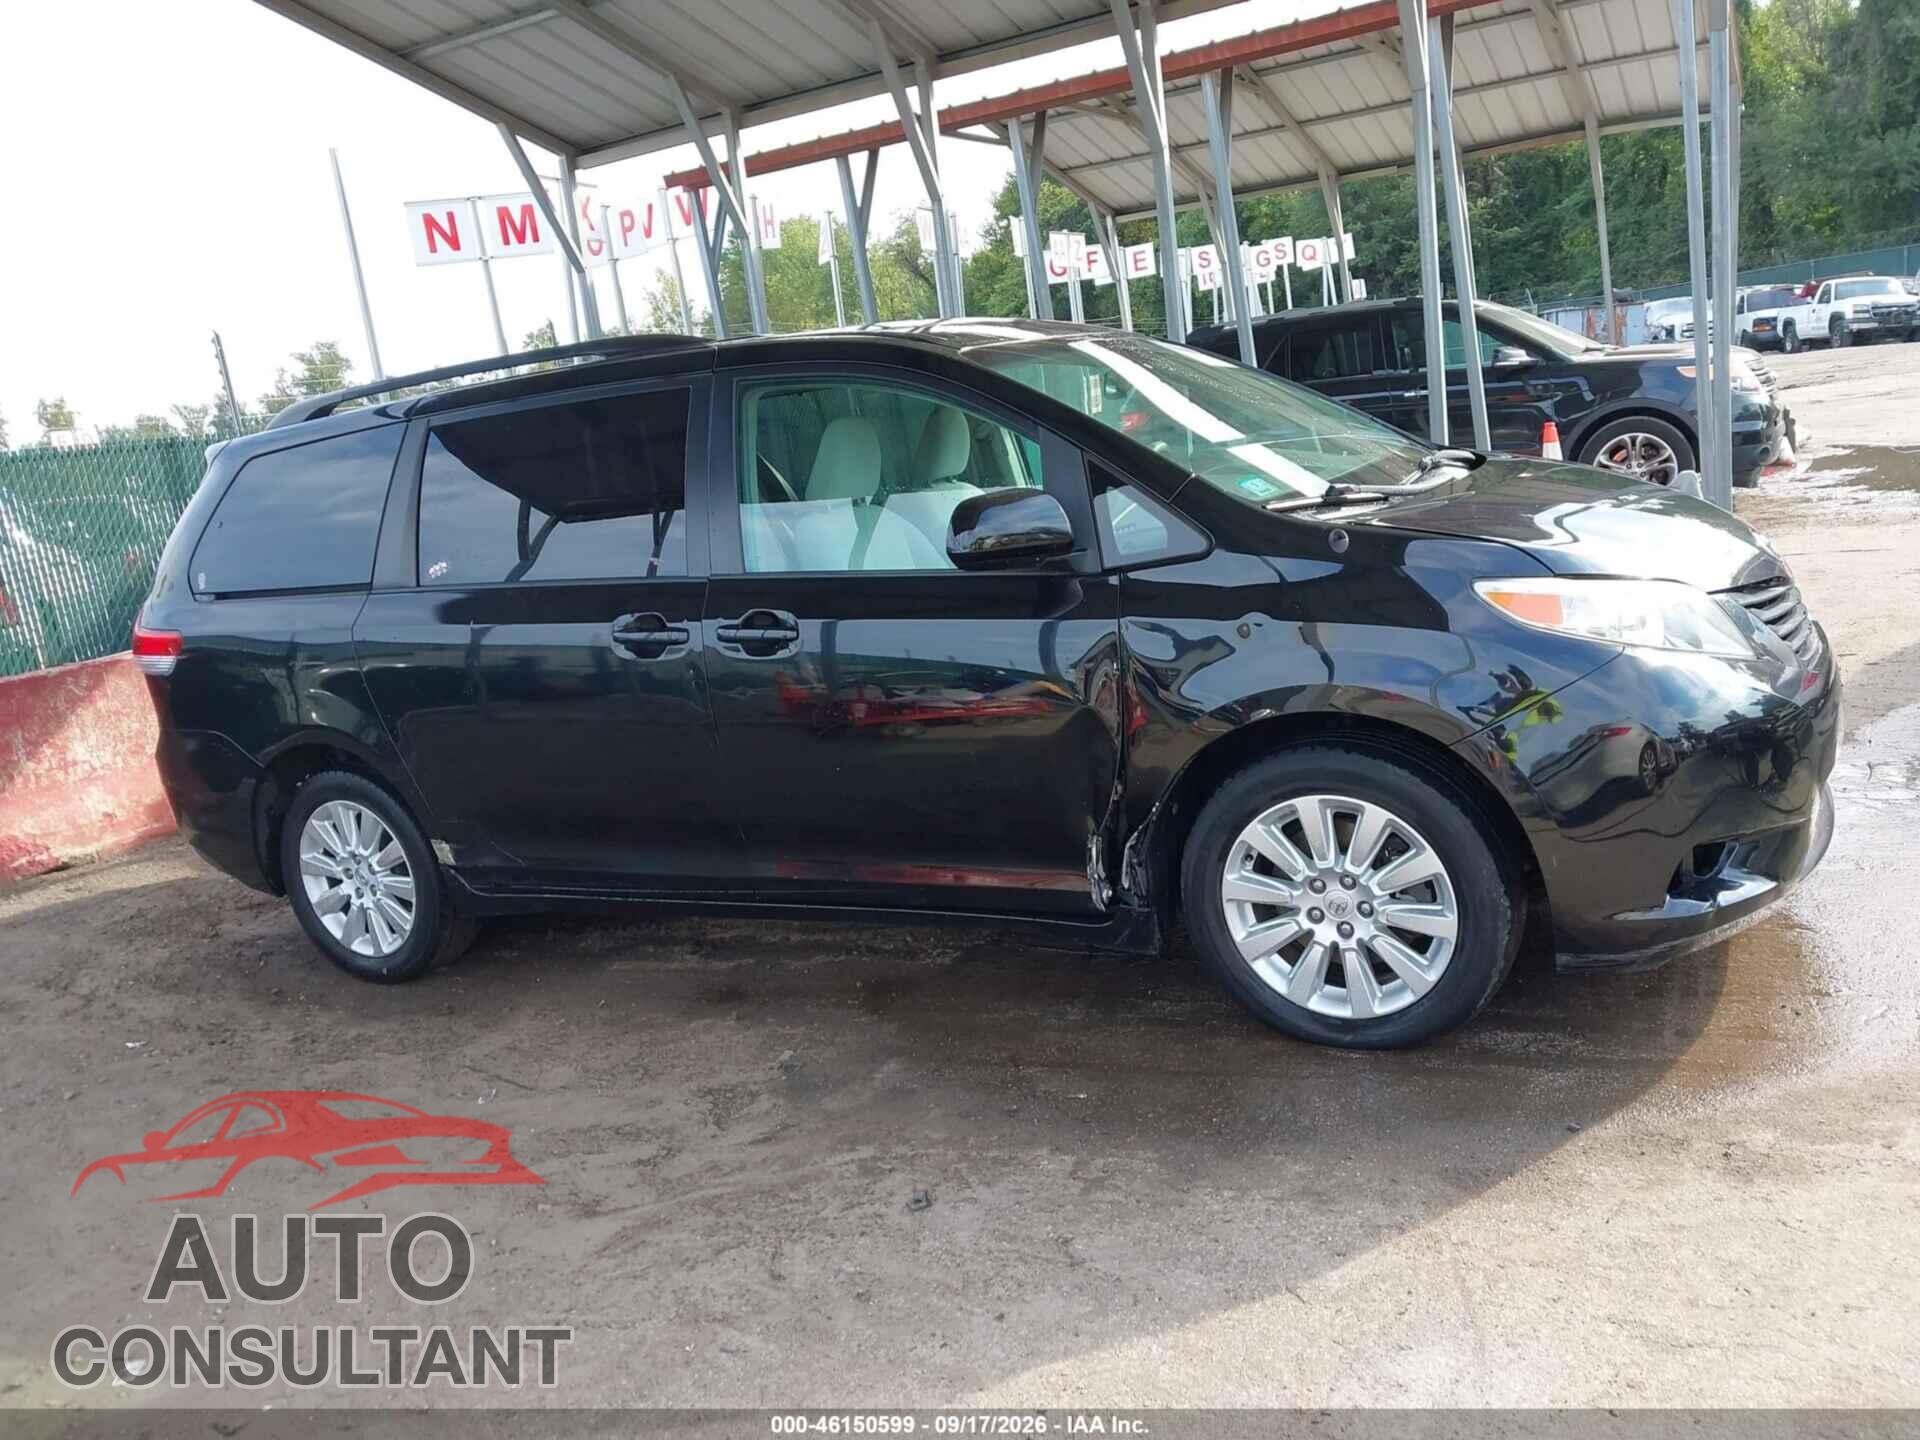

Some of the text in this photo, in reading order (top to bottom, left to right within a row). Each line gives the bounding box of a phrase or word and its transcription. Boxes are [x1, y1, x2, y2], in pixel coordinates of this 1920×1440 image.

[421, 210, 461, 253] N
[496, 204, 540, 246] M
[619, 210, 634, 248] P
[763, 203, 776, 239] H
[1086, 250, 1098, 272] F
[1133, 250, 1148, 272] E
[1198, 250, 1212, 268] S
[1256, 250, 1271, 267] G
[1274, 243, 1287, 260] S
[1302, 245, 1316, 261] Q
